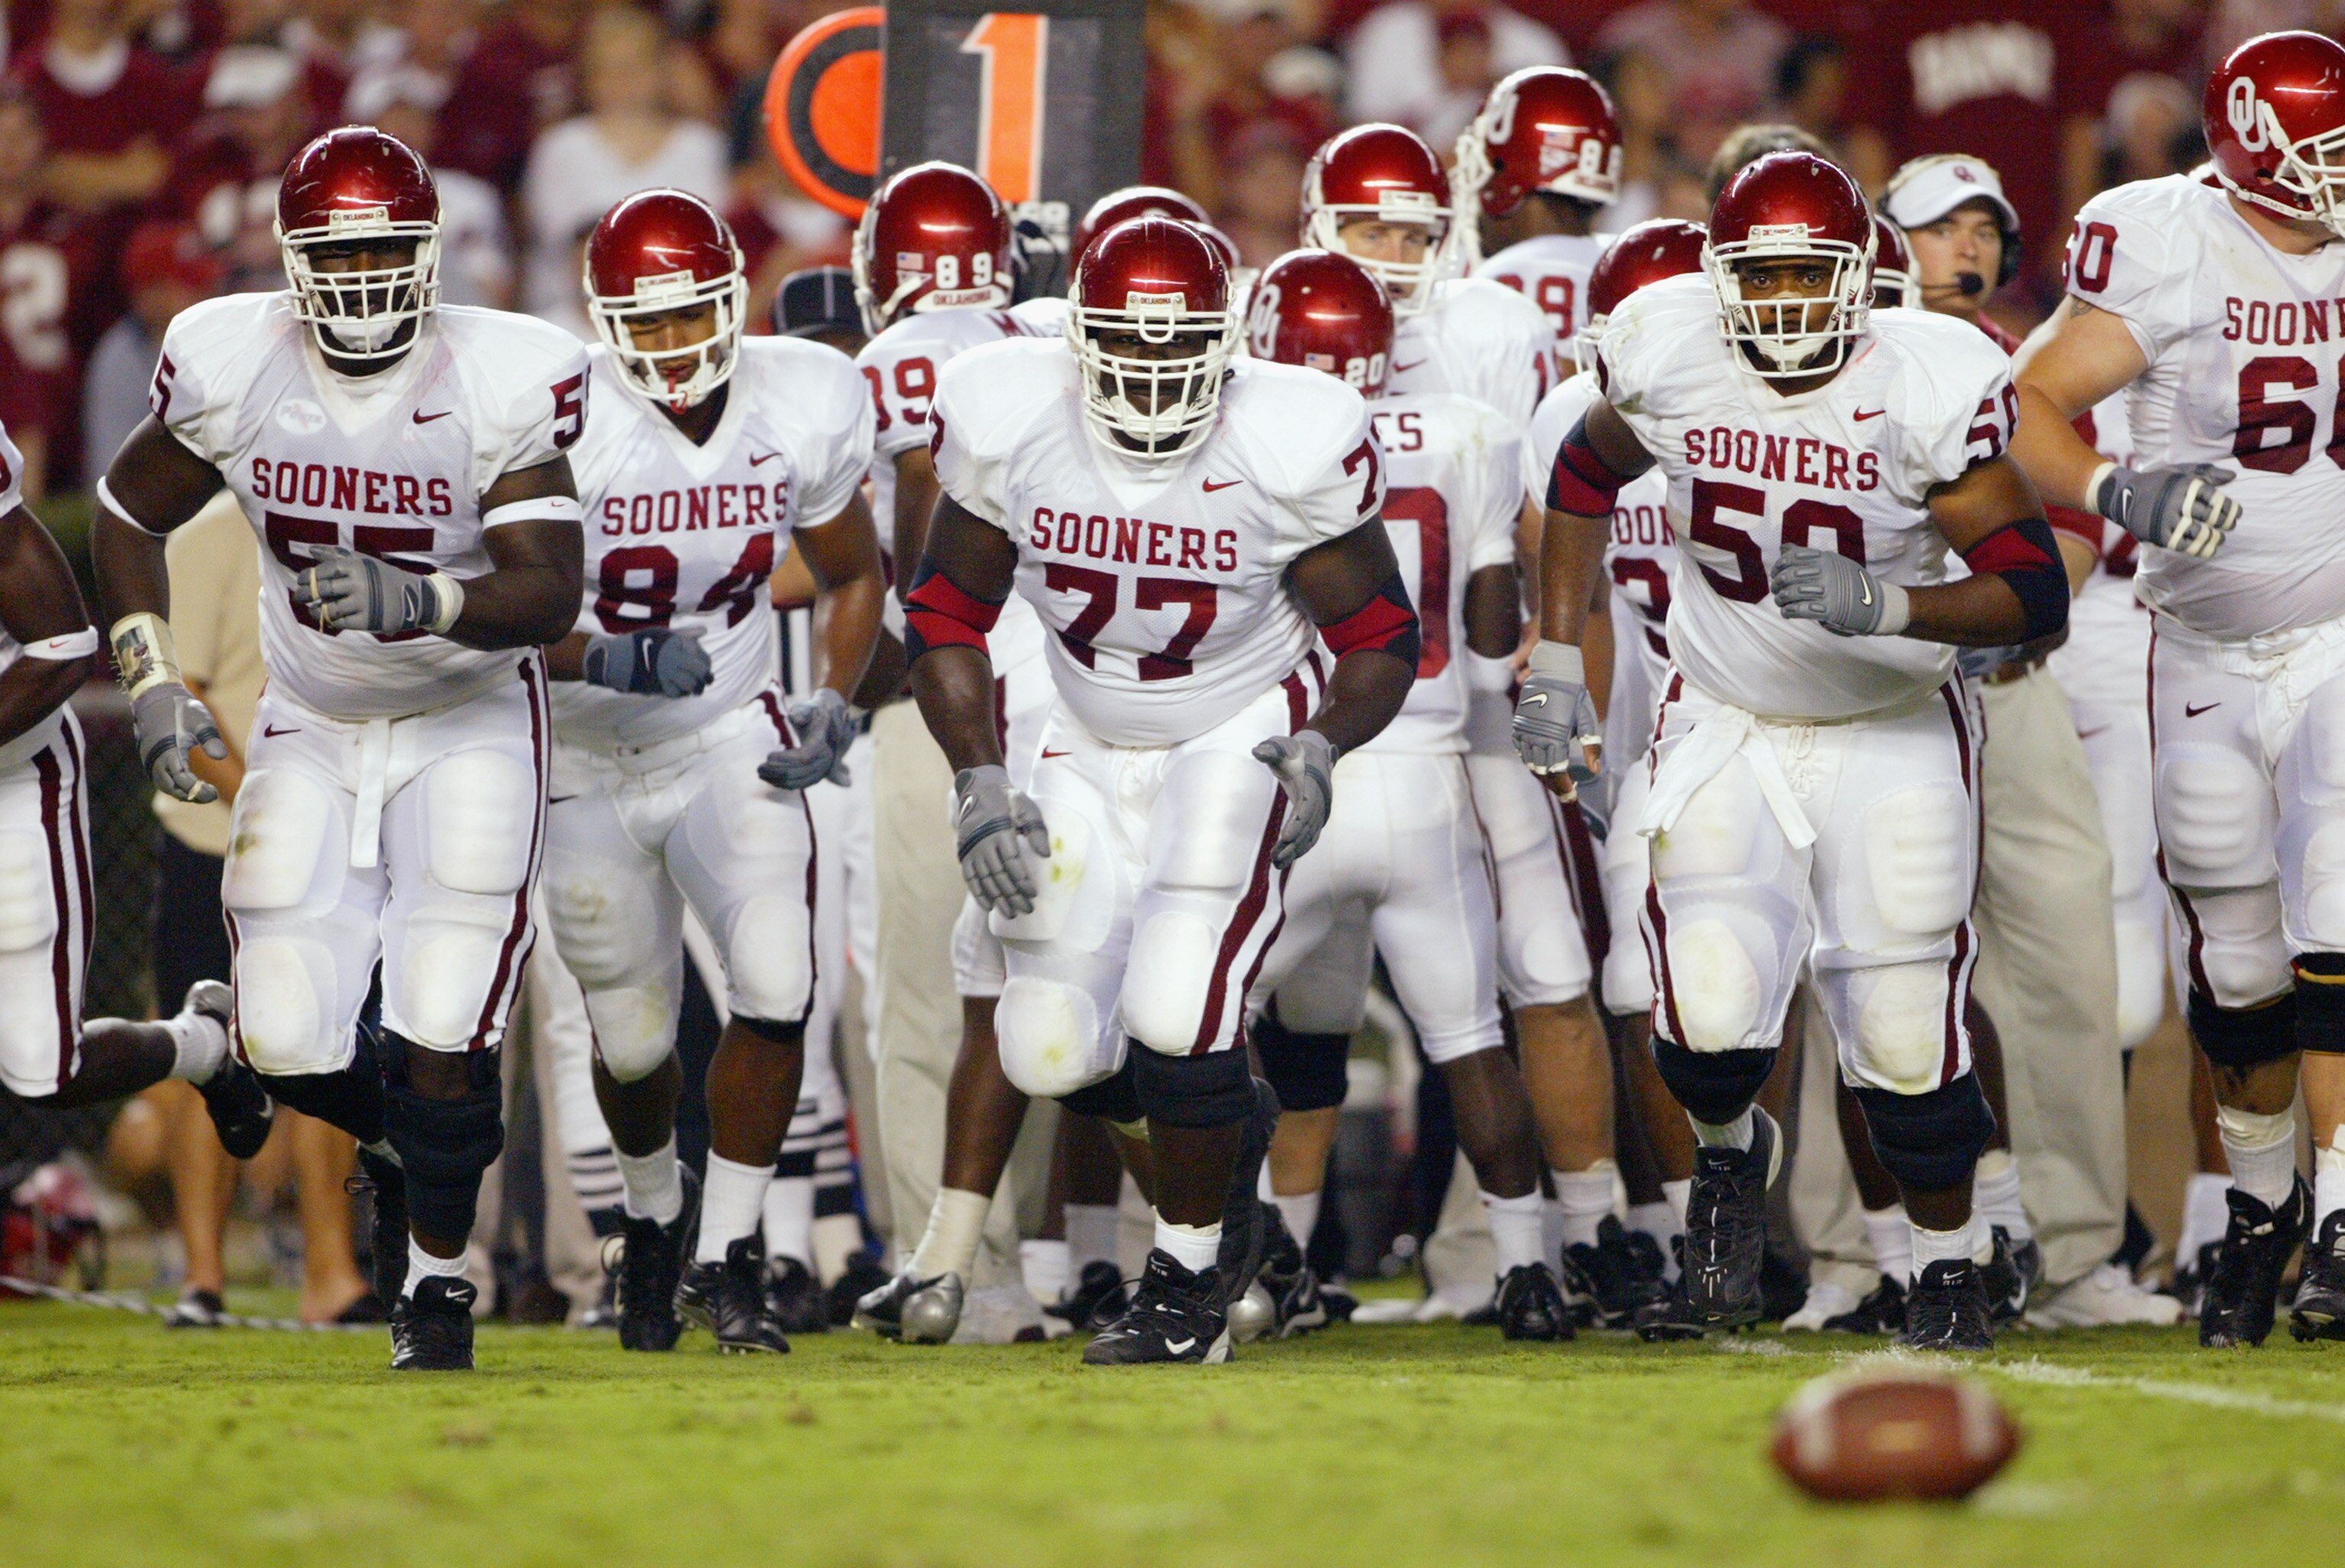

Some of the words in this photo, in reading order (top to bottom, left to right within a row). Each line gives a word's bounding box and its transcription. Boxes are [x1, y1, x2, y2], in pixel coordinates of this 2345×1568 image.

[960, 12, 1048, 204] 1
[936, 254, 992, 289] 89
[2223, 296, 2345, 346] SOON
[1345, 352, 1386, 388] 20
[2232, 355, 2345, 475] 6
[252, 458, 453, 517] SOONERS
[1684, 426, 1878, 492] SOONERS
[602, 481, 788, 537] SOONERS
[1030, 507, 1237, 573] SOONERS
[593, 531, 774, 635] 84
[1046, 562, 1217, 681] 77
